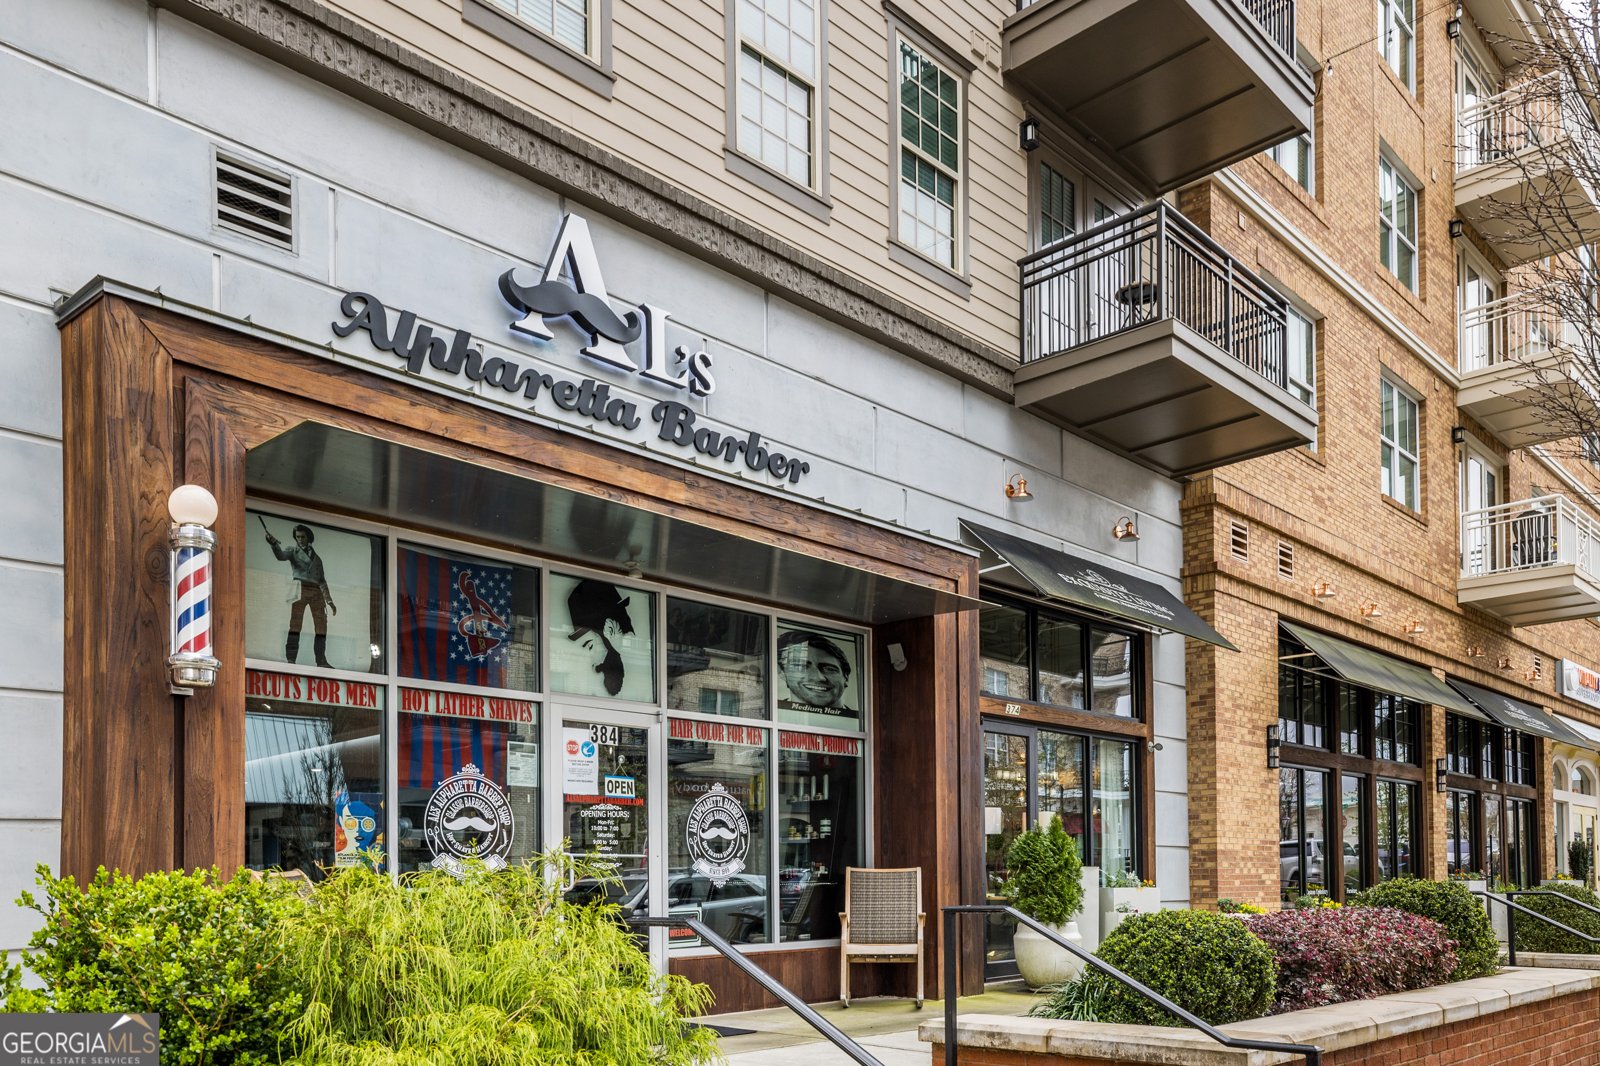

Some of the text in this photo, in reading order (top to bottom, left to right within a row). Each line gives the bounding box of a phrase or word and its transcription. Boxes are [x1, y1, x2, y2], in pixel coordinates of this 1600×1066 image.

[331, 291, 811, 483] Alpharetta Barber
[306, 678, 340, 704] FOR
[346, 682, 377, 708] MEN
[402, 688, 533, 723] HOT LATHER SHAVES
[791, 703, 841, 715] Medium Hair
[1006, 704, 1020, 714] 374
[591, 725, 617, 744] 384
[670, 719, 763, 746] HAIR COLOR FOR MEN
[780, 732, 858, 755] GROOMING PRODUCTS
[567, 744, 579, 752] STOP
[606, 780, 634, 795] OPEN
[436, 780, 477, 809] ALPHARETTA
[478, 782, 502, 808] BARBER
[498, 805, 511, 826] SHOP
[445, 797, 495, 819] CLASSIC BARBERSHOP
[580, 810, 606, 818] OPENING
[693, 796, 723, 820] ALPHARETTA
[724, 798, 741, 820] BARBER
[738, 816, 748, 834] SHOP
[714, 811, 736, 829] BARBERSHOP
